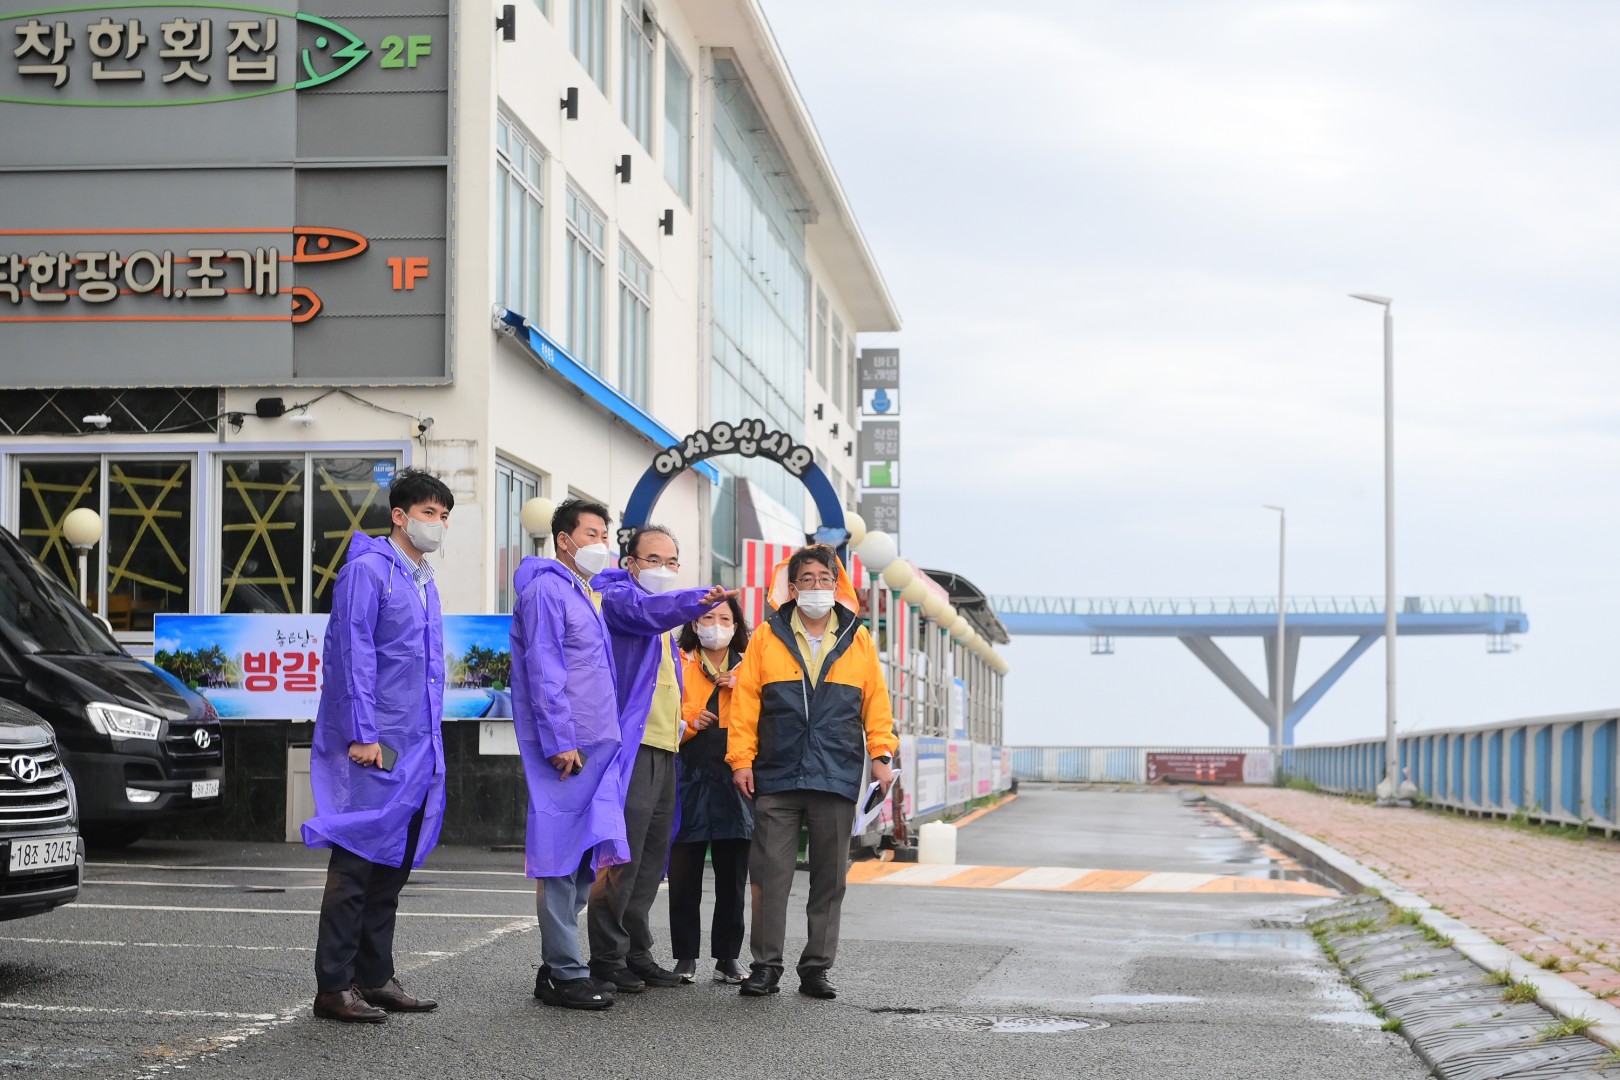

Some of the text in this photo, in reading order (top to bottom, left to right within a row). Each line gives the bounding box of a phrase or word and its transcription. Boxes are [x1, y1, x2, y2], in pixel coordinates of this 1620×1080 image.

[13, 17, 279, 87] 착한횟집
[379, 35, 432, 69] 2F
[387, 256, 430, 291] 1F
[243, 651, 325, 692] 방갈
[17, 841, 72, 867] 18조 3243
